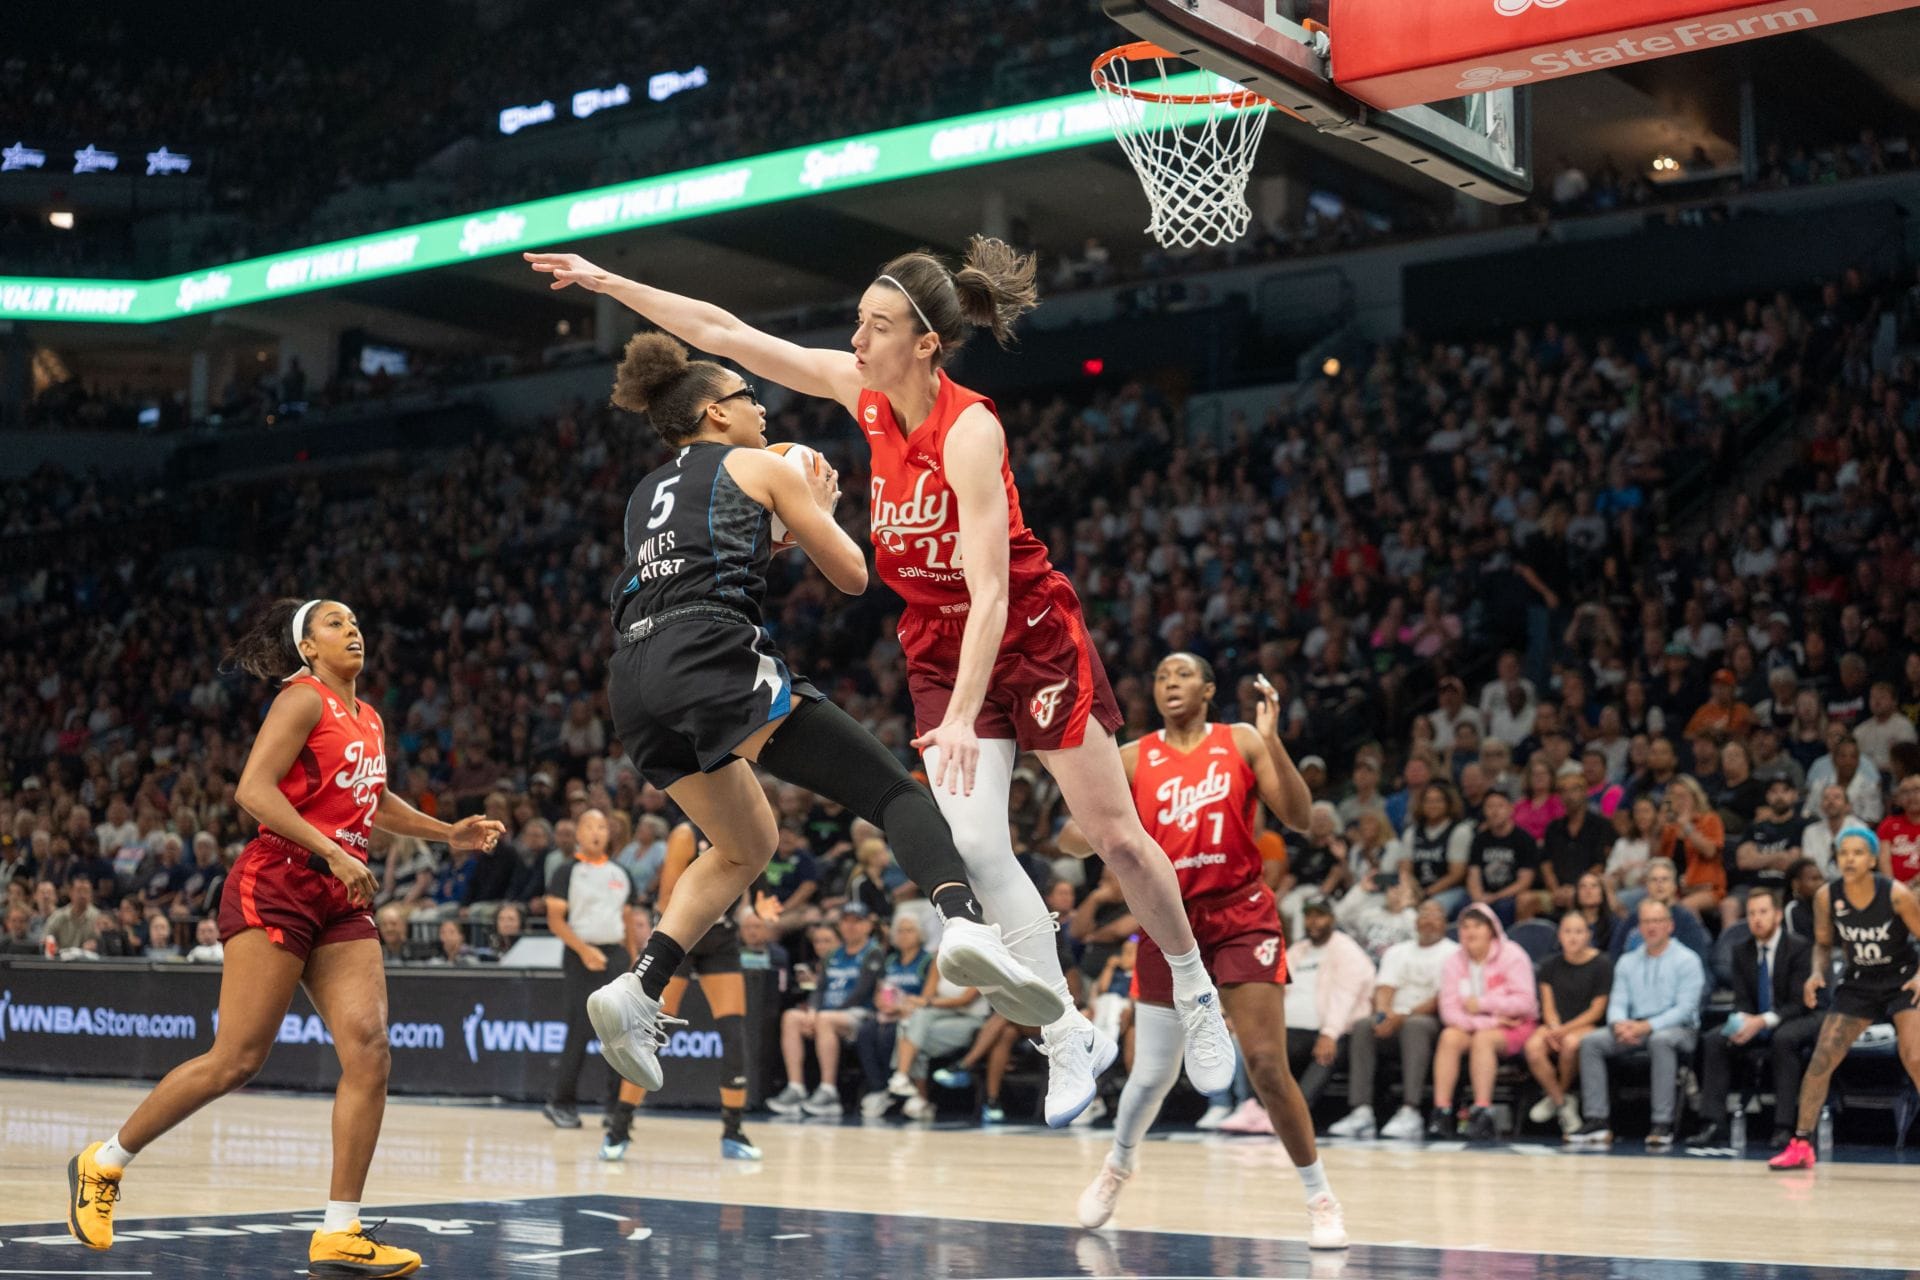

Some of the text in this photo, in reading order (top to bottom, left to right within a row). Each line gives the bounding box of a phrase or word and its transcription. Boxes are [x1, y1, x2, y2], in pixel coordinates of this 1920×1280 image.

[646, 473, 682, 530] 5
[871, 469, 949, 534] Indy
[637, 530, 675, 566] MILES
[914, 531, 963, 569] 22
[641, 558, 685, 583] AT&T
[335, 736, 387, 789] Ind
[1156, 760, 1231, 825] Indy
[1208, 812, 1224, 845] 7
[1835, 920, 1893, 941] LYNX
[1854, 942, 1882, 960] 10
[9, 1004, 196, 1040] WNBAStore.com
